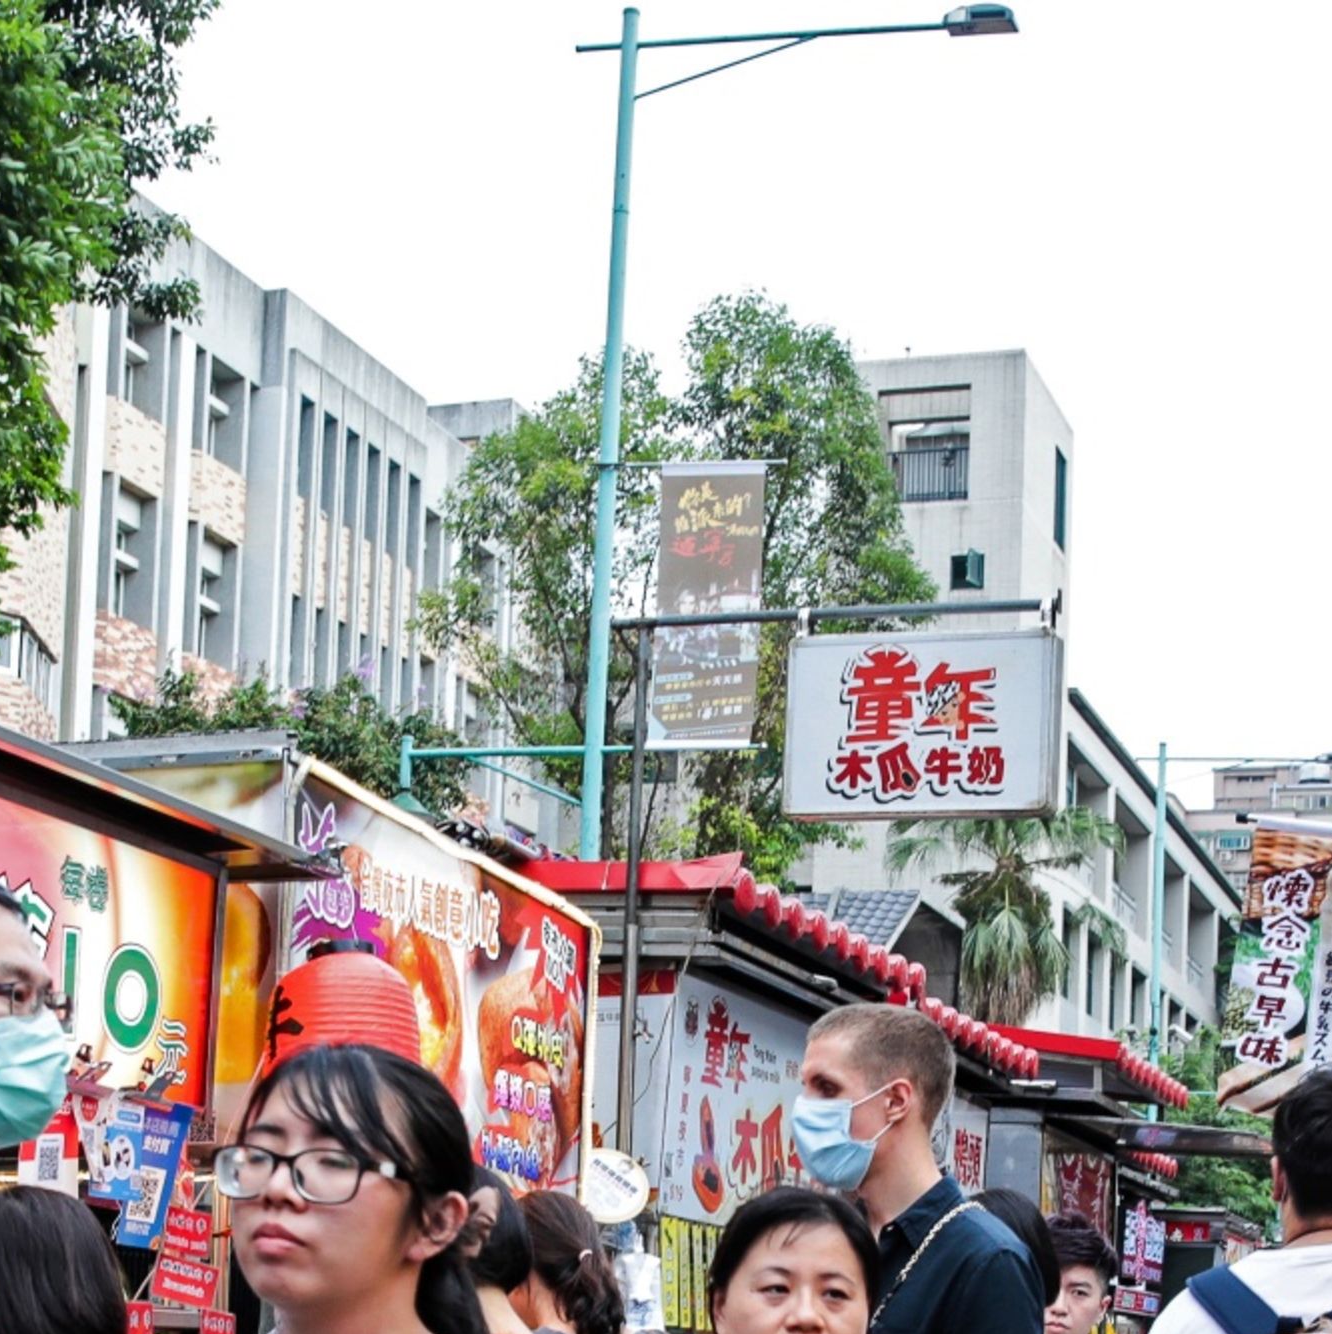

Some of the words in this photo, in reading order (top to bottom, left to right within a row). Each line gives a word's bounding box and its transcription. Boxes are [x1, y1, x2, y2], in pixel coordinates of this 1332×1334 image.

[841, 644, 998, 744] 童年
[833, 744, 1005, 794] 木瓜牛奶
[1239, 872, 1315, 1064] 懷念古早味
[701, 997, 751, 1094] 童年
